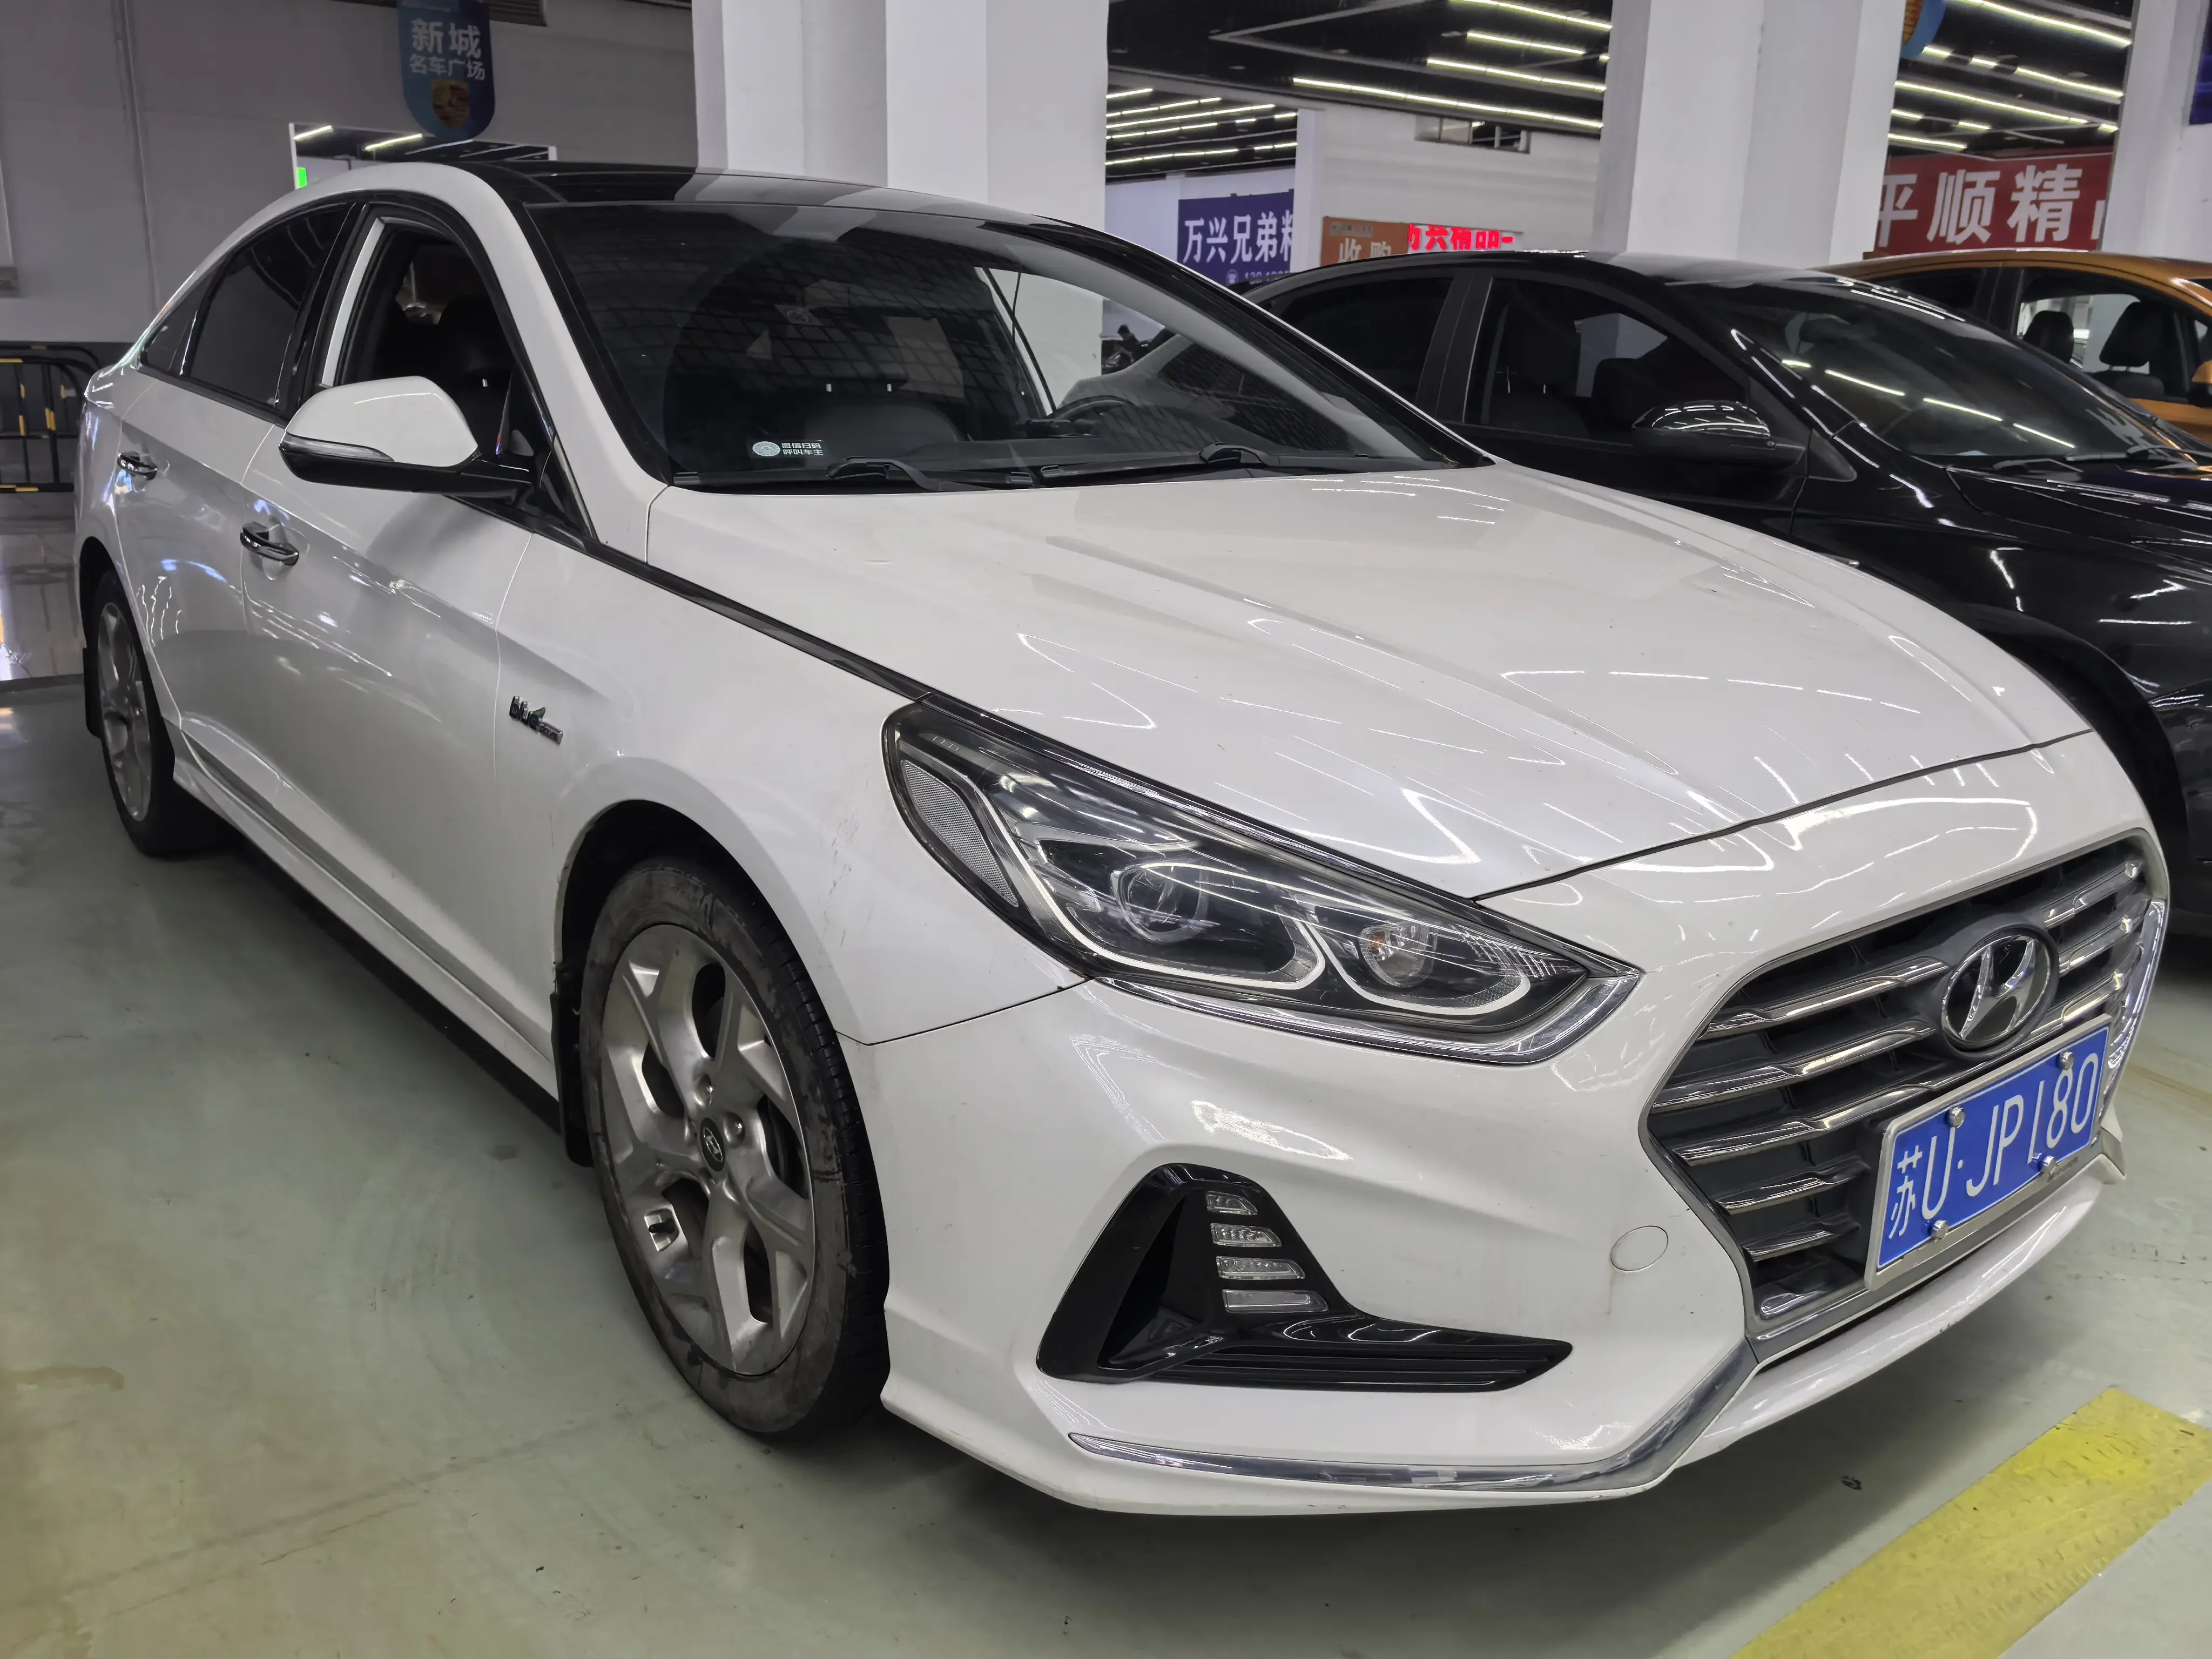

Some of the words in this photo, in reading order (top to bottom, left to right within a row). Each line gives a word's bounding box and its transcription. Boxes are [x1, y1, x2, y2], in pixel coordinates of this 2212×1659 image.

[410, 18, 482, 59] 新城
[409, 54, 485, 80] 名车广场
[1878, 164, 2105, 247] 平顺精
